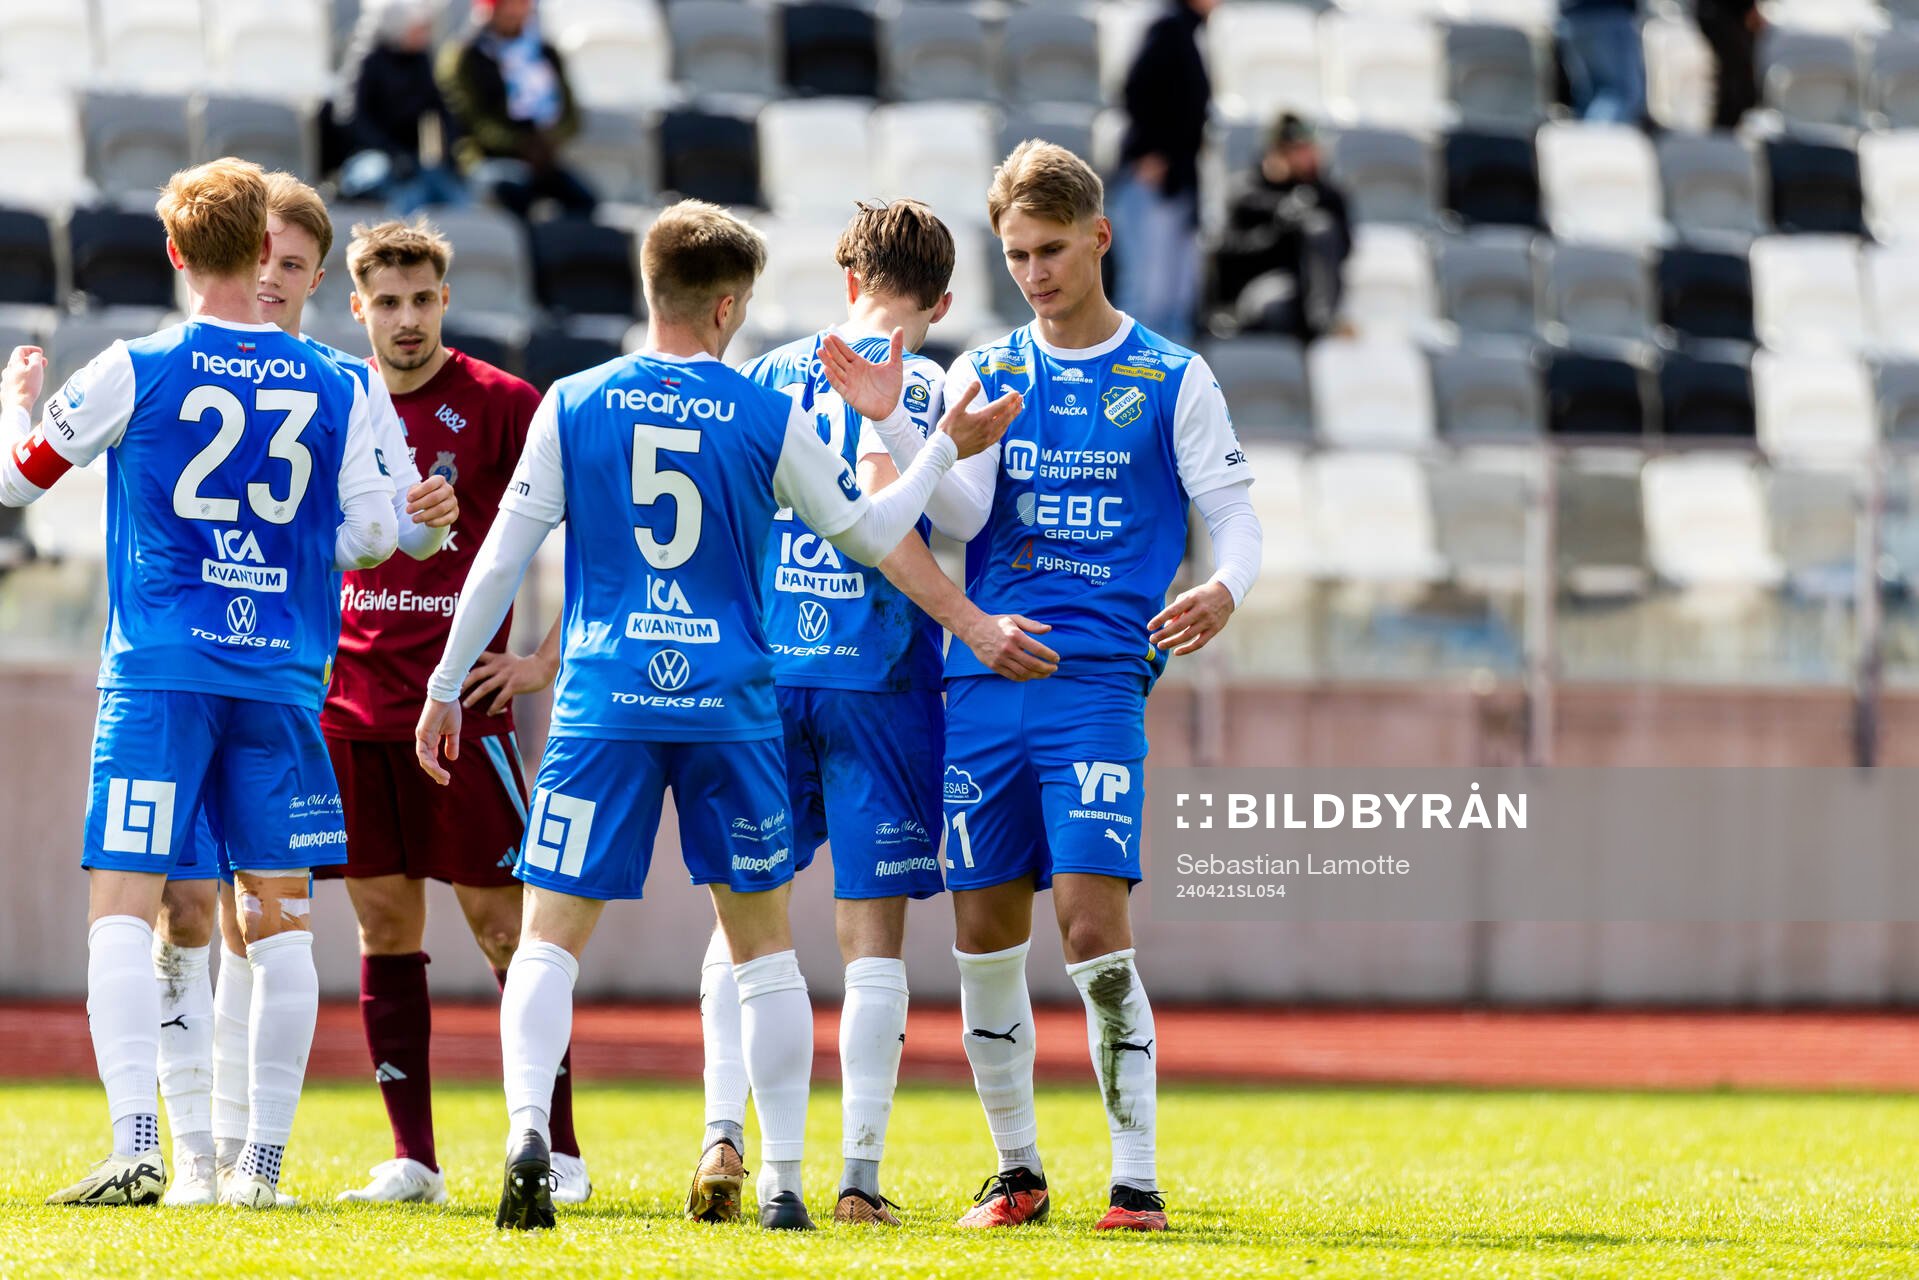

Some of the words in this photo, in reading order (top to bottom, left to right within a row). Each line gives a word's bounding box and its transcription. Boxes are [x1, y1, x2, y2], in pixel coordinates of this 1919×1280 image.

[192, 351, 306, 384] nearyou
[606, 388, 735, 423] nearyou
[1049, 405, 1088, 416] ANACKA
[435, 403, 467, 434] 1882
[173, 384, 318, 525] 23
[1041, 448, 1131, 465] MATTSSON
[1040, 465, 1117, 479] GRUPPEN
[630, 422, 704, 570] 5
[1036, 494, 1123, 527] EBC
[213, 529, 266, 563] ICA
[1044, 529, 1113, 540] GROUP
[781, 532, 842, 569] ICA
[208, 564, 281, 587] KVANTUM
[1036, 556, 1112, 579] FYRSTADS
[353, 588, 397, 612] Gävle
[399, 590, 460, 617] Energi
[646, 574, 694, 614] ICA
[190, 627, 268, 648] TOVEKS
[269, 639, 291, 649] BIL
[632, 618, 713, 637] KVANTUM
[769, 643, 831, 657] OVEKS
[833, 645, 860, 657] BIL
[611, 692, 696, 708] TOVEKS
[698, 697, 725, 708] BIL
[944, 782, 969, 795] ESAB
[1072, 761, 1131, 805] YP
[875, 822, 900, 834] Two
[1068, 810, 1132, 825] YRKESBUTIKER
